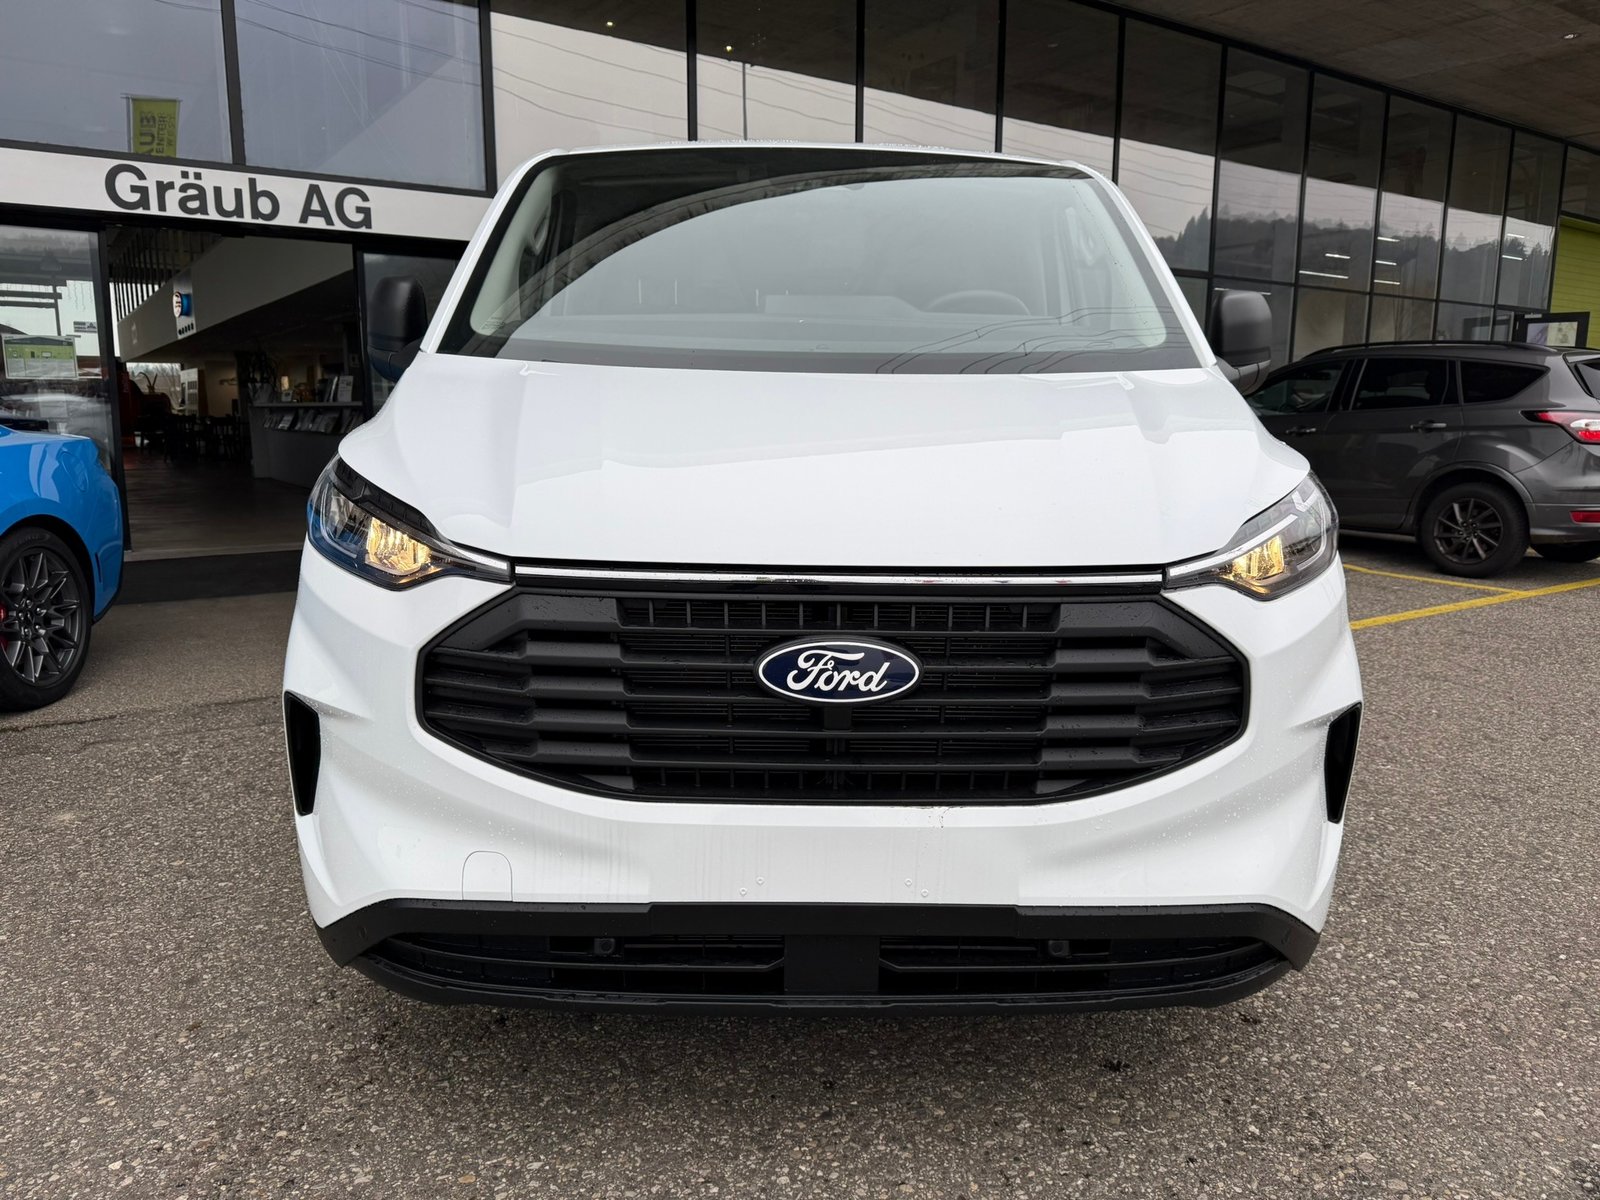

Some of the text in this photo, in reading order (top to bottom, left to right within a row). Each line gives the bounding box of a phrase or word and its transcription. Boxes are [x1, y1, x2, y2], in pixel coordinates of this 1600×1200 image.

[105, 163, 372, 229] Gräub AG
[787, 650, 890, 692] Ford
